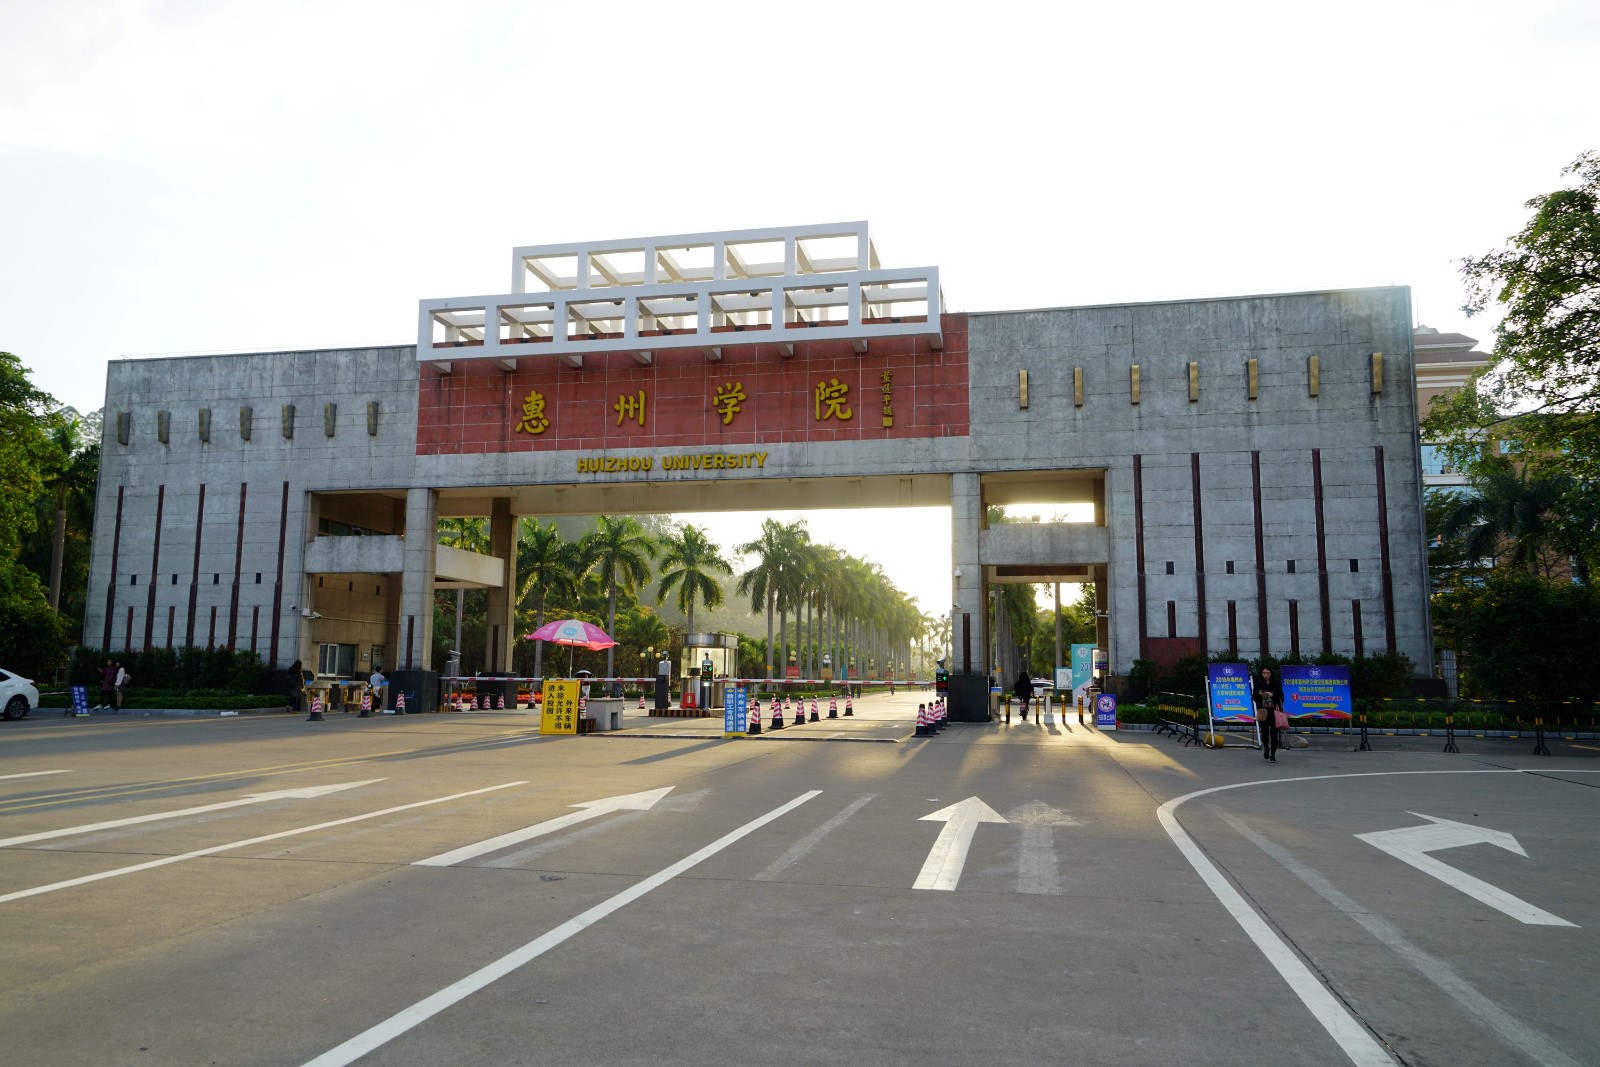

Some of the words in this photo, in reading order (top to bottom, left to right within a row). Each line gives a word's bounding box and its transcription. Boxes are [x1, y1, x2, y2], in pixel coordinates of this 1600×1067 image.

[515, 378, 853, 435] 惠州学院
[577, 456, 653, 472] HUIZHOU
[661, 451, 769, 470] UNIVERSITY
[546, 685, 556, 715] 进入校园
[555, 685, 565, 730] 未经允许不得
[564, 700, 573, 730] 外来车辆
[726, 693, 734, 732] 教职工专用通道
[737, 693, 745, 732] 外来车辆通道
